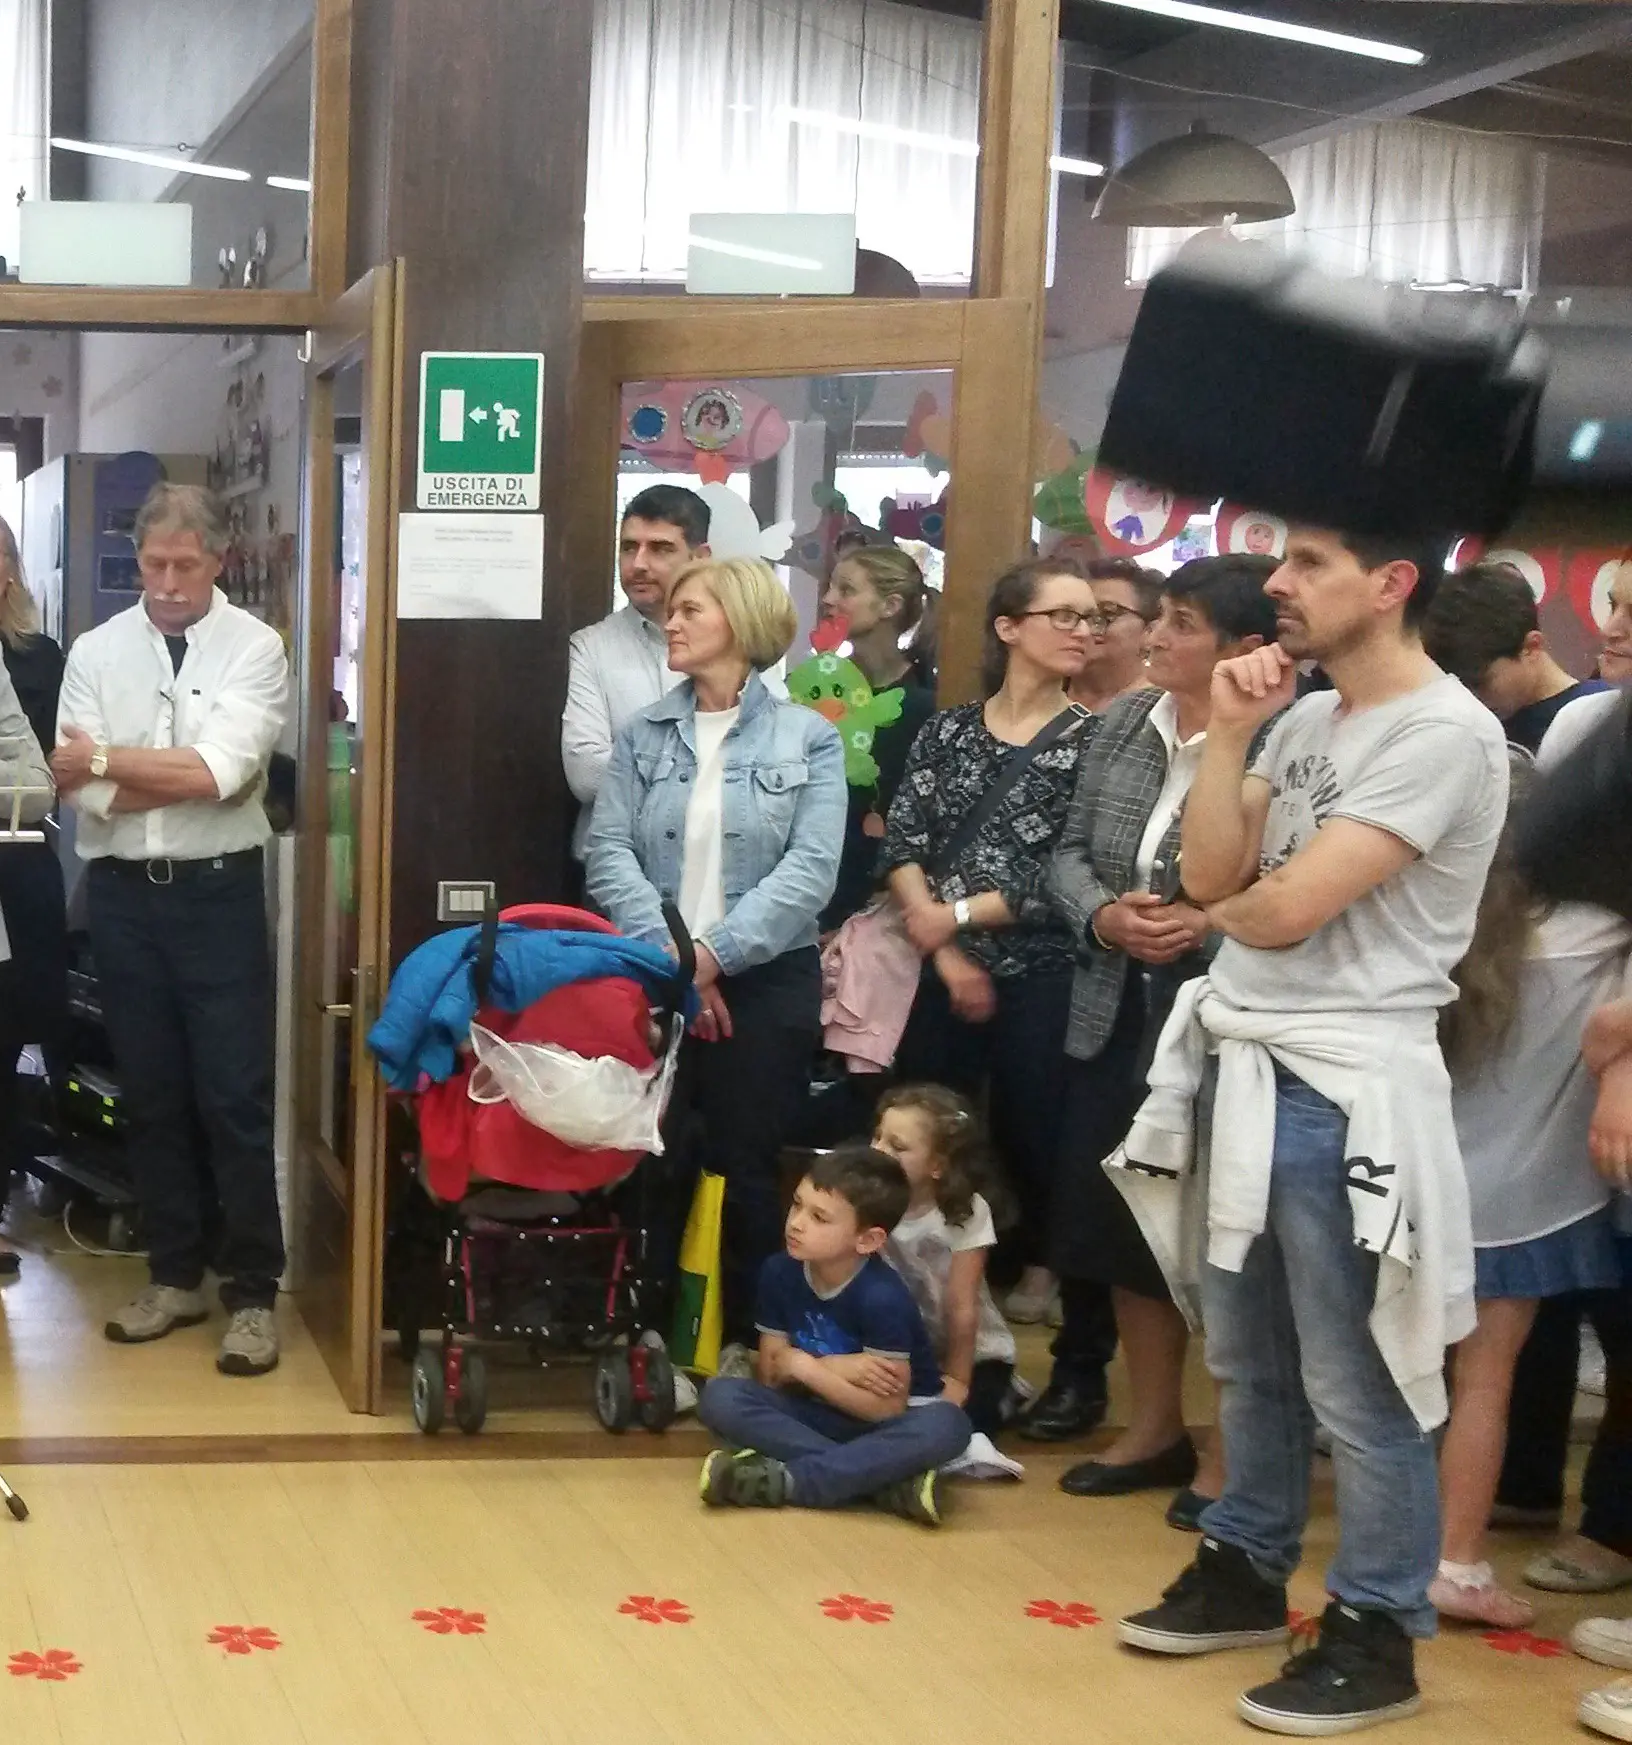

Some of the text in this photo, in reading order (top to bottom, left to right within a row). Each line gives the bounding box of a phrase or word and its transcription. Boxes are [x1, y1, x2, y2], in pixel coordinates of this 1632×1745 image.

[433, 477, 523, 490] USCITA DI
[427, 492, 528, 506] EMERGENZA
